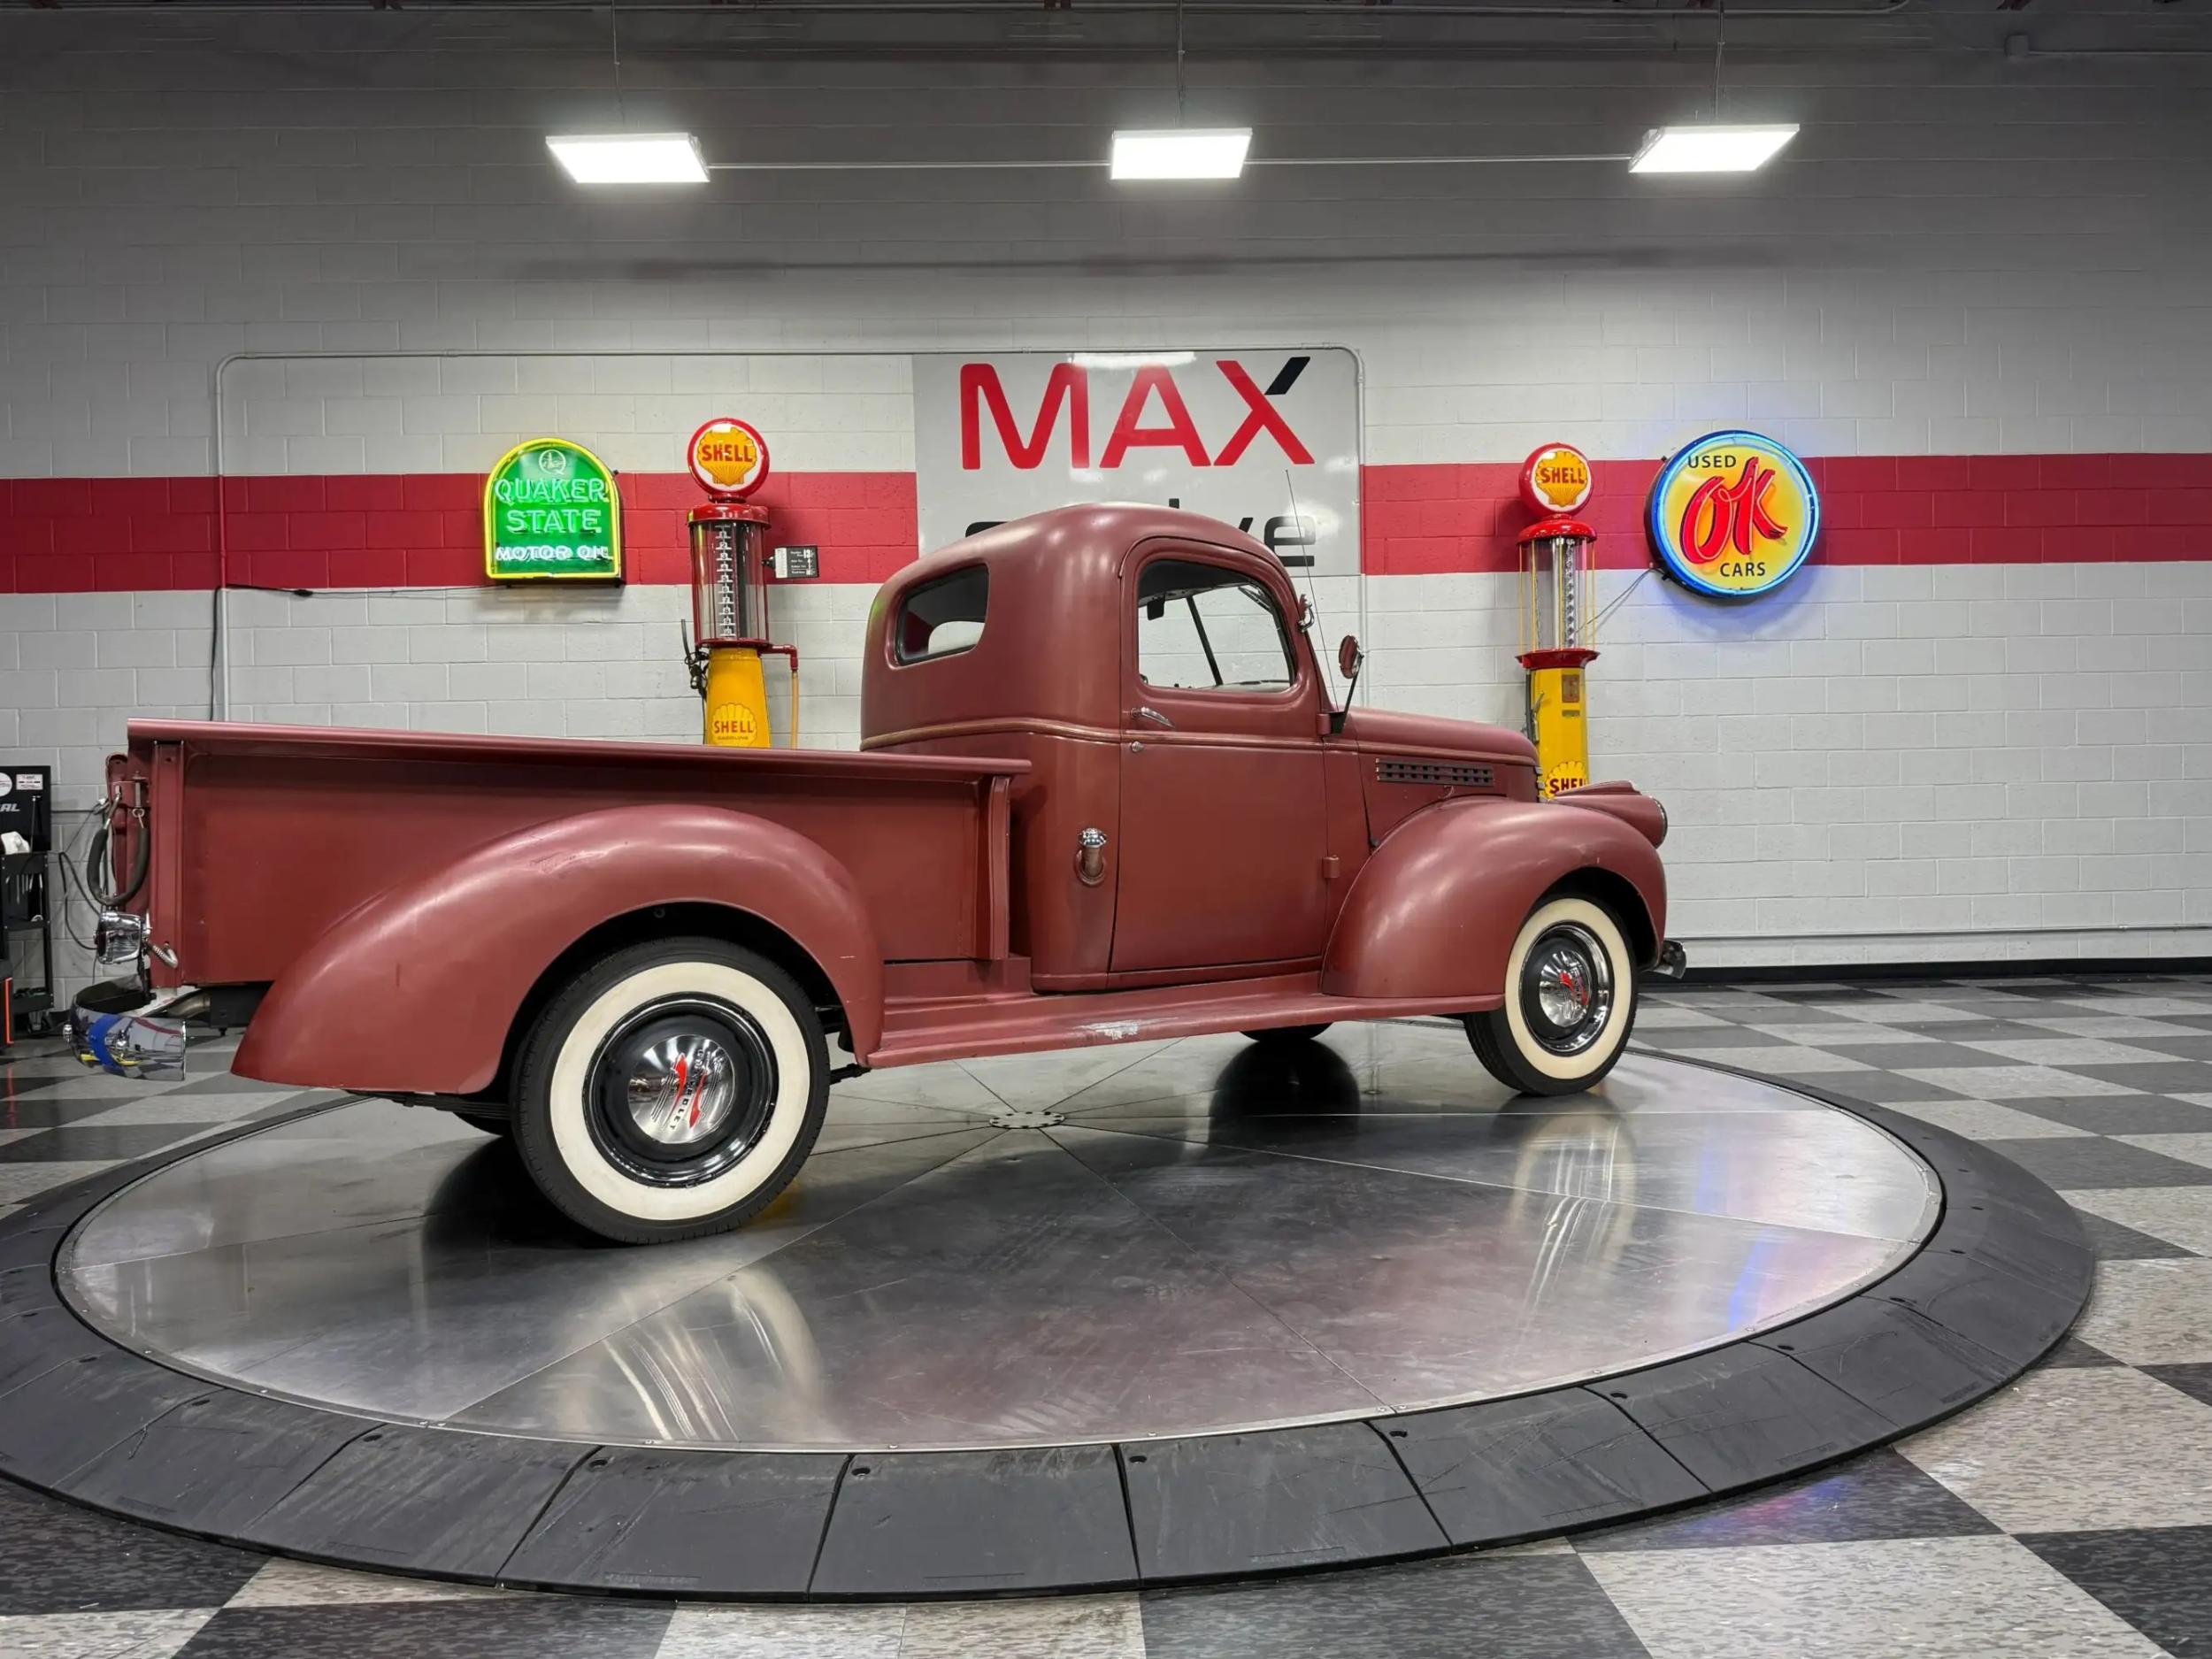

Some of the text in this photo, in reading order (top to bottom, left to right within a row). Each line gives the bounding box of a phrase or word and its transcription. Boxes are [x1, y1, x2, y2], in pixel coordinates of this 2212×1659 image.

[959, 356, 1316, 470] MAX
[701, 443, 753, 463] SHELL
[1687, 455, 1737, 469] USED
[1540, 466, 1586, 484] SHELL
[495, 477, 611, 507] QUAKER
[505, 509, 603, 534] STATE
[495, 544, 614, 562] MOTOR OIL
[1719, 562, 1766, 577] CARS
[714, 720, 754, 733] SHELL
[1549, 778, 1586, 794] SHE
[0, 803, 20, 812] AL
